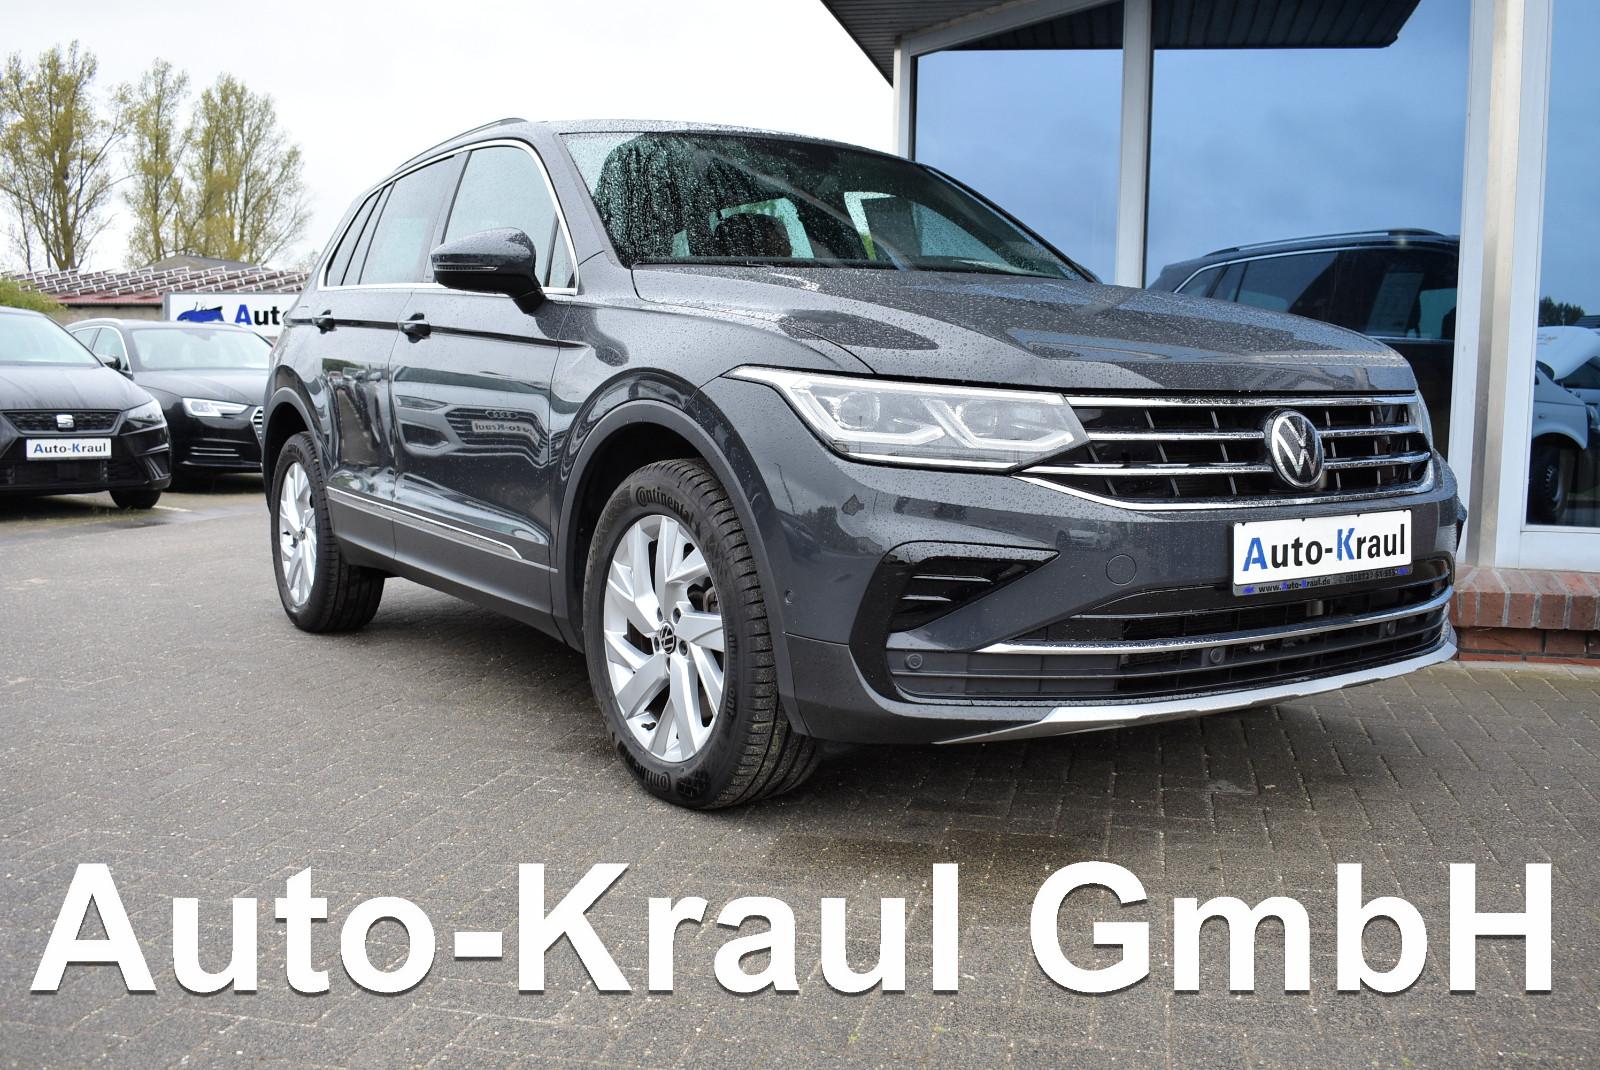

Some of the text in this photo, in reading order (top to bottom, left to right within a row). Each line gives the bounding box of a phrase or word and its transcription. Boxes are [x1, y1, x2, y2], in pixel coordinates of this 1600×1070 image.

[33, 442, 106, 454] Auto-Kraul
[635, 485, 695, 528] Continental
[1242, 523, 1406, 572] Auto-Kraul
